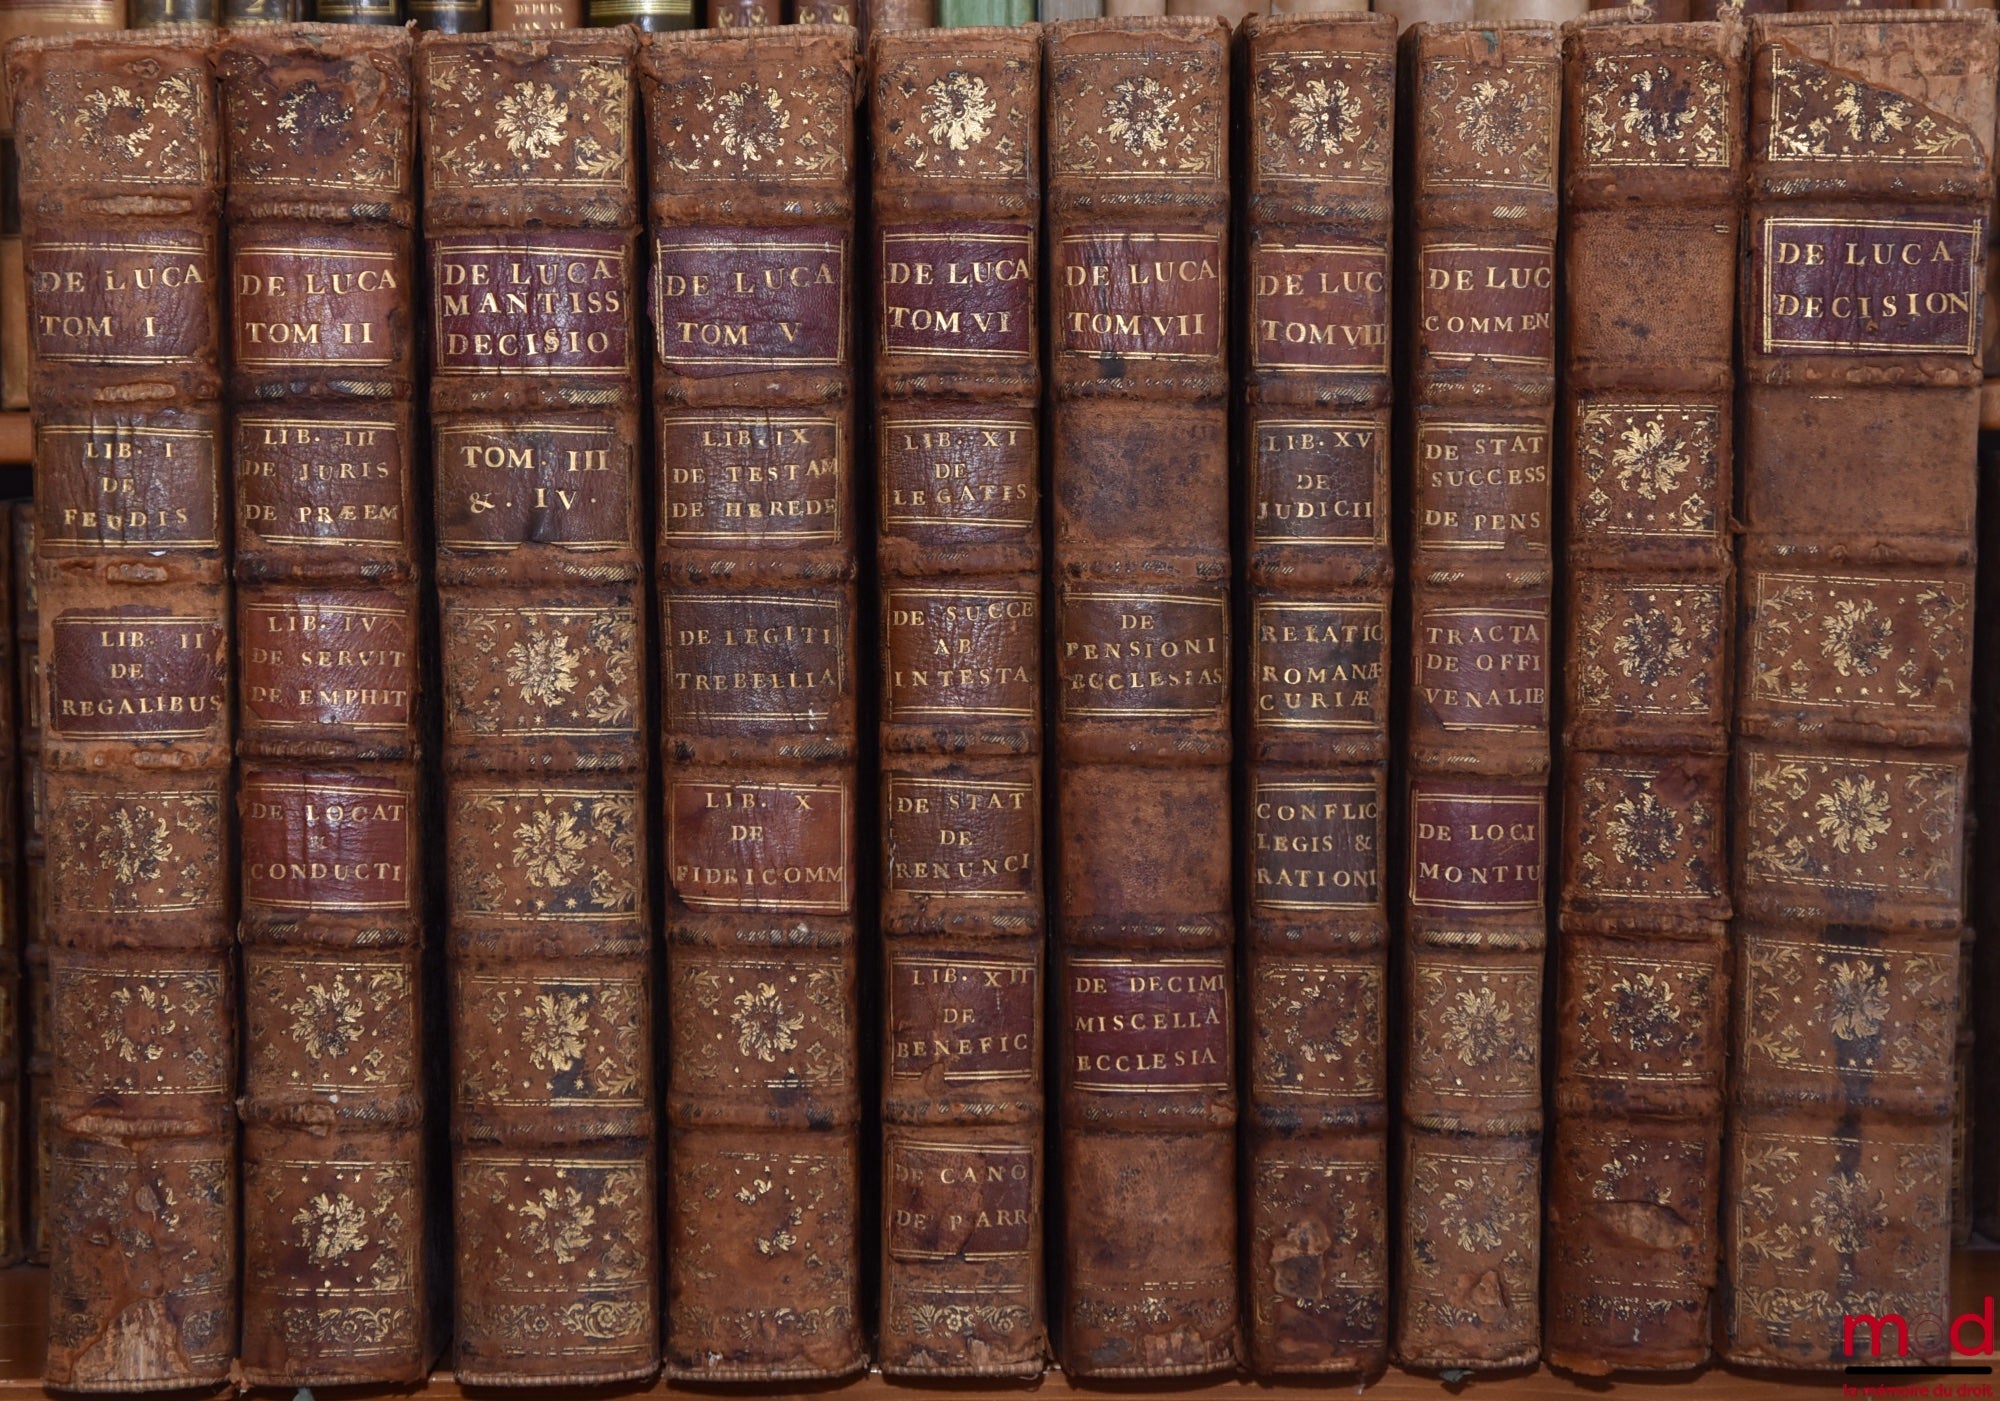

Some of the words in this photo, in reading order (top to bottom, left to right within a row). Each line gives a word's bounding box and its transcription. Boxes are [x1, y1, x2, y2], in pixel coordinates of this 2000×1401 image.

[1777, 242, 1824, 265] DE
[1845, 240, 1953, 266] LUCA
[38, 271, 85, 293] DE
[105, 263, 205, 291] LUCA
[443, 263, 489, 286] DE
[511, 258, 614, 286] LUCA
[664, 274, 710, 298] DE
[735, 263, 835, 294] LUCA
[888, 262, 934, 285] DE
[948, 259, 1030, 284] LUCA
[1066, 265, 1110, 286] DE
[1129, 259, 1217, 284] LUCA
[1427, 267, 1474, 291] DE
[1486, 266, 1551, 289] LUC
[240, 274, 286, 297] DE
[305, 269, 397, 296] LUCA
[1257, 275, 1304, 296] DE
[1319, 271, 1384, 293] LUC
[443, 290, 621, 318] MANTISS
[1776, 291, 1970, 318] DECISION
[40, 316, 113, 337] TOM
[145, 316, 156, 338] I
[888, 306, 960, 333] TOM
[971, 311, 1013, 333] VI
[1425, 312, 1550, 333] COMMEN
[246, 322, 321, 344] TOM
[342, 323, 374, 344] II
[446, 328, 609, 357] DECISIO
[676, 321, 750, 347] TOM
[780, 322, 801, 344] V
[264, 429, 321, 445] LIB.
[345, 430, 376, 446] III
[704, 430, 764, 446] LIB.
[776, 428, 810, 446] IX
[905, 432, 963, 450] LIB.
[982, 430, 1017, 447] XI
[1267, 434, 1324, 452] LIB.
[1333, 431, 1373, 449] XV
[1425, 444, 1459, 460] DE
[1475, 435, 1543, 455] STAT
[86, 442, 143, 459] LIB.
[165, 442, 173, 458] I
[566, 449, 610, 473] III
[243, 460, 276, 477] DE
[300, 462, 389, 481] JURIS
[673, 468, 706, 484] DE
[935, 463, 968, 479] DE
[1432, 465, 1545, 488] SUCCESS
[102, 477, 135, 494] DE
[1296, 474, 1331, 490] DE
[893, 483, 1028, 506] LEGATIS
[64, 508, 188, 531] FEUDIS
[245, 504, 278, 521] DE
[672, 502, 705, 518] DE
[1257, 500, 1372, 520] JUDICII
[1425, 509, 1458, 527] DE
[1475, 511, 1541, 531] PENS
[268, 615, 327, 633] LIB.
[345, 616, 378, 633] IV
[893, 609, 925, 627] DE
[945, 602, 1034, 622] SUCCE
[1121, 614, 1154, 630] DE
[101, 631, 155, 648] LIB.
[181, 633, 204, 649] II
[679, 629, 711, 647] DE
[726, 626, 831, 646] LEGITI
[1427, 624, 1540, 645] TRACTA
[934, 638, 972, 656] AB
[1066, 637, 1215, 660] PENSIONI
[251, 648, 285, 665] DE
[301, 650, 406, 668] SERVIT
[1426, 653, 1459, 672] DE
[1476, 654, 1541, 671] OFFI
[110, 663, 144, 679] DE
[675, 669, 837, 691] TREBELLIA
[895, 665, 1030, 688] INTESTA
[62, 695, 223, 717] REGALIBUS
[252, 686, 283, 703] DE
[299, 689, 406, 708] EMPHIT
[1425, 688, 1545, 708] VENALIB
[706, 792, 767, 808] LIB.
[795, 794, 813, 810] X
[898, 796, 929, 814] DE
[950, 792, 1025, 810] STAT
[252, 802, 284, 820] DE
[306, 804, 404, 823] LOCAT
[731, 825, 764, 842] DE
[940, 829, 973, 846] DE
[1257, 833, 1333, 852] LEGIS
[1354, 834, 1372, 852] &
[1419, 823, 1451, 841] DE
[1470, 824, 1535, 841] LOCI
[251, 863, 400, 881] CONDUCTI
[677, 865, 843, 885] FIDEICOMM
[896, 853, 1030, 879] RENUNCI
[1257, 867, 1376, 888] RATIONI
[912, 967, 967, 985] LIB.
[983, 969, 1028, 987] XII
[1075, 977, 1107, 993] DE
[1130, 974, 1224, 992] DECIMI
[943, 1008, 975, 1023] DE
[1075, 1007, 1220, 1033] MISCELLA
[896, 1034, 1027, 1058] BENEFIC
[1077, 1048, 1216, 1072] ECCLESIA
[896, 1164, 924, 1184] DE
[940, 1164, 1026, 1184] CANO
[897, 1209, 926, 1230] DE
[949, 1209, 1028, 1231] PARR
